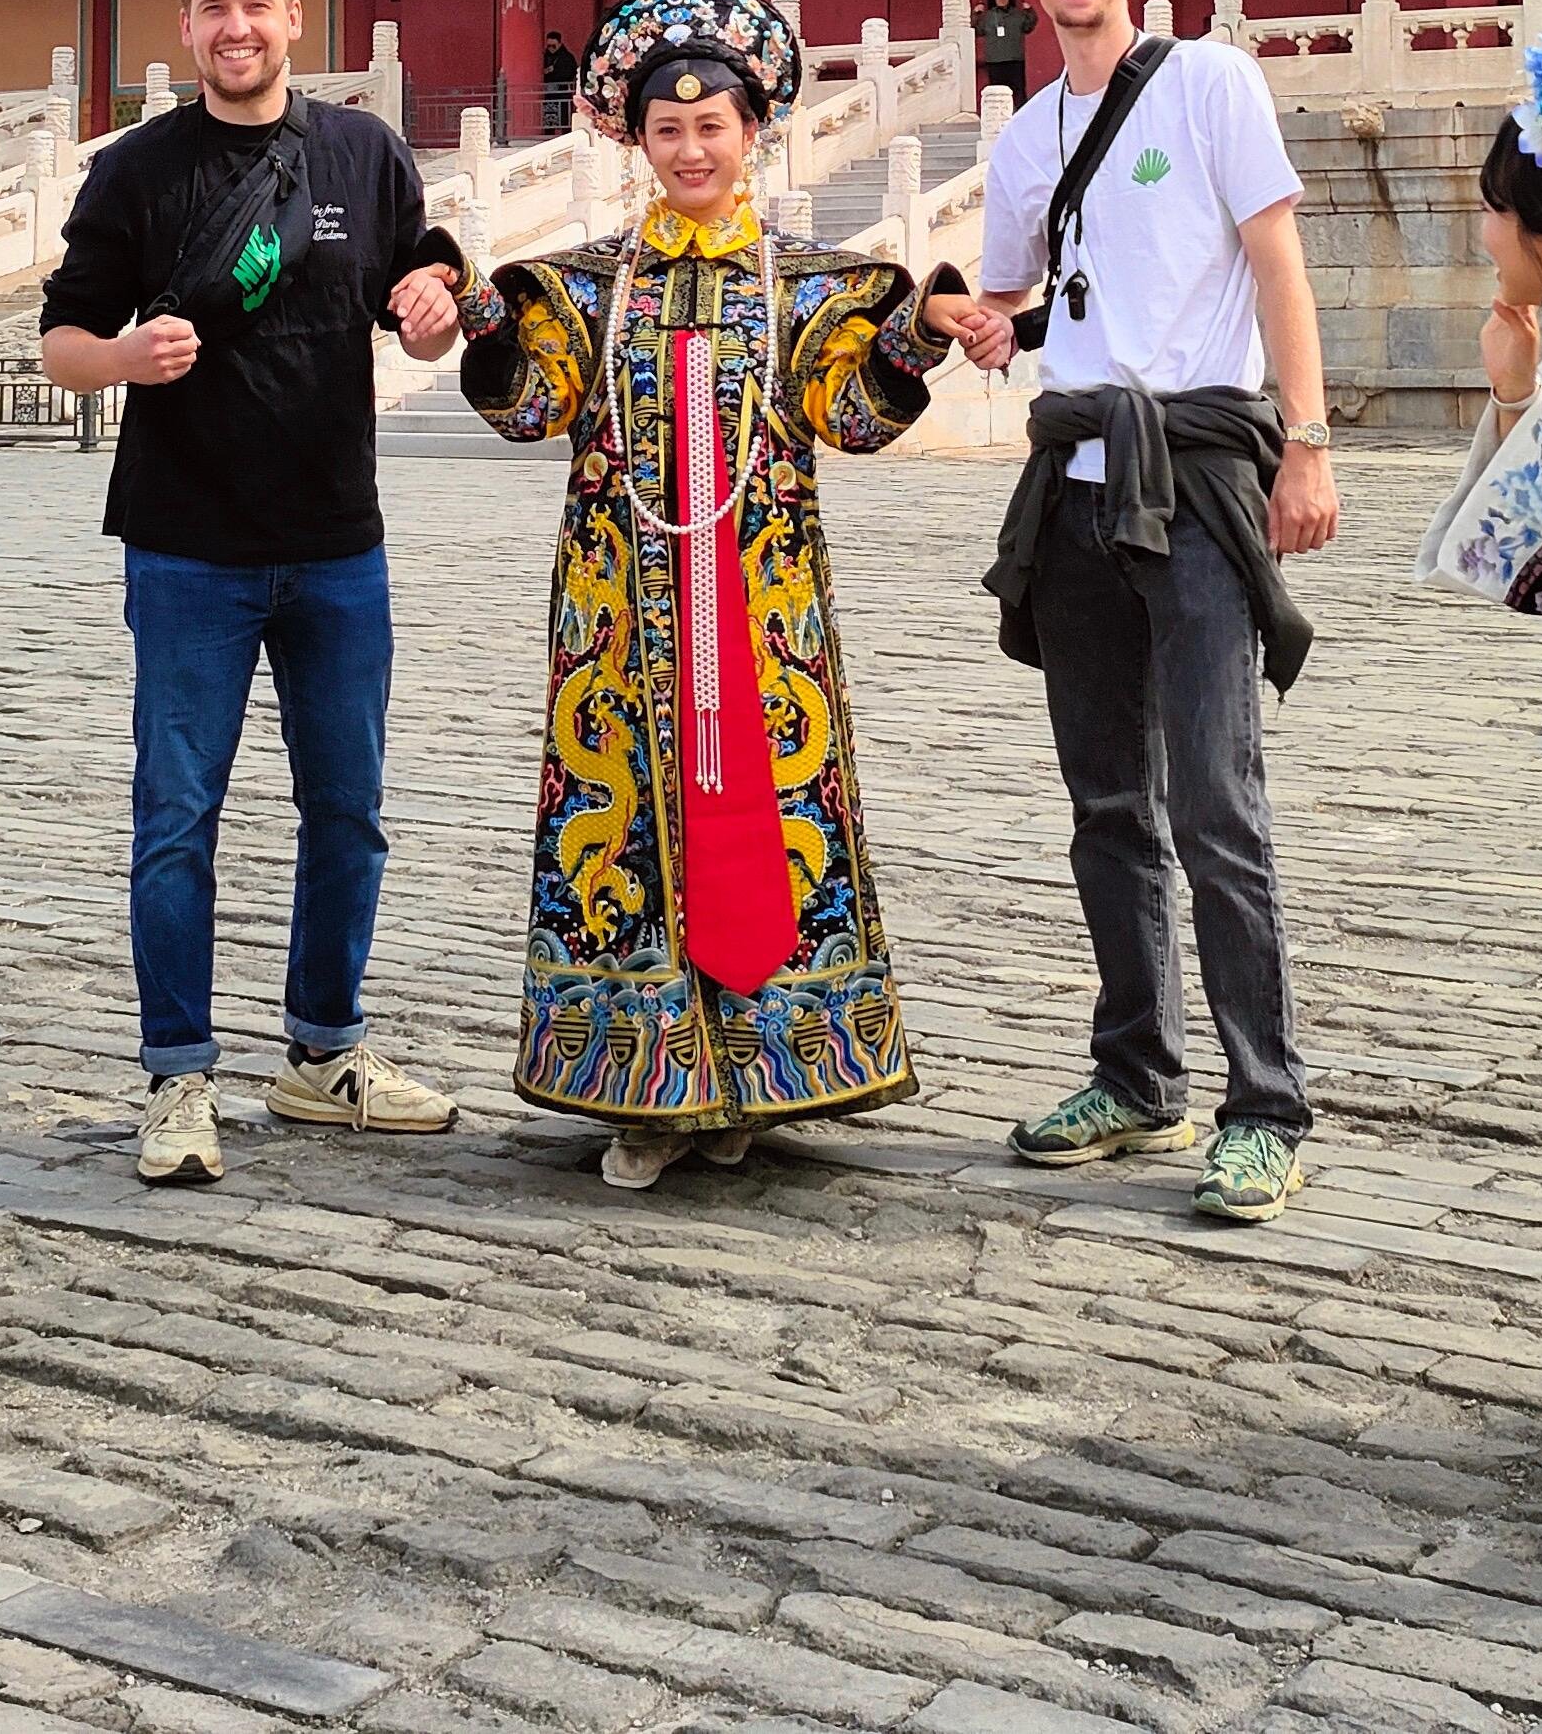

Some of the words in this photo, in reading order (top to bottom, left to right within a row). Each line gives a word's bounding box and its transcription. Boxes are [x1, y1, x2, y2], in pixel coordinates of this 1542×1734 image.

[319, 203, 345, 217] from
[314, 219, 340, 230] Paris
[232, 224, 274, 292] NIKE
